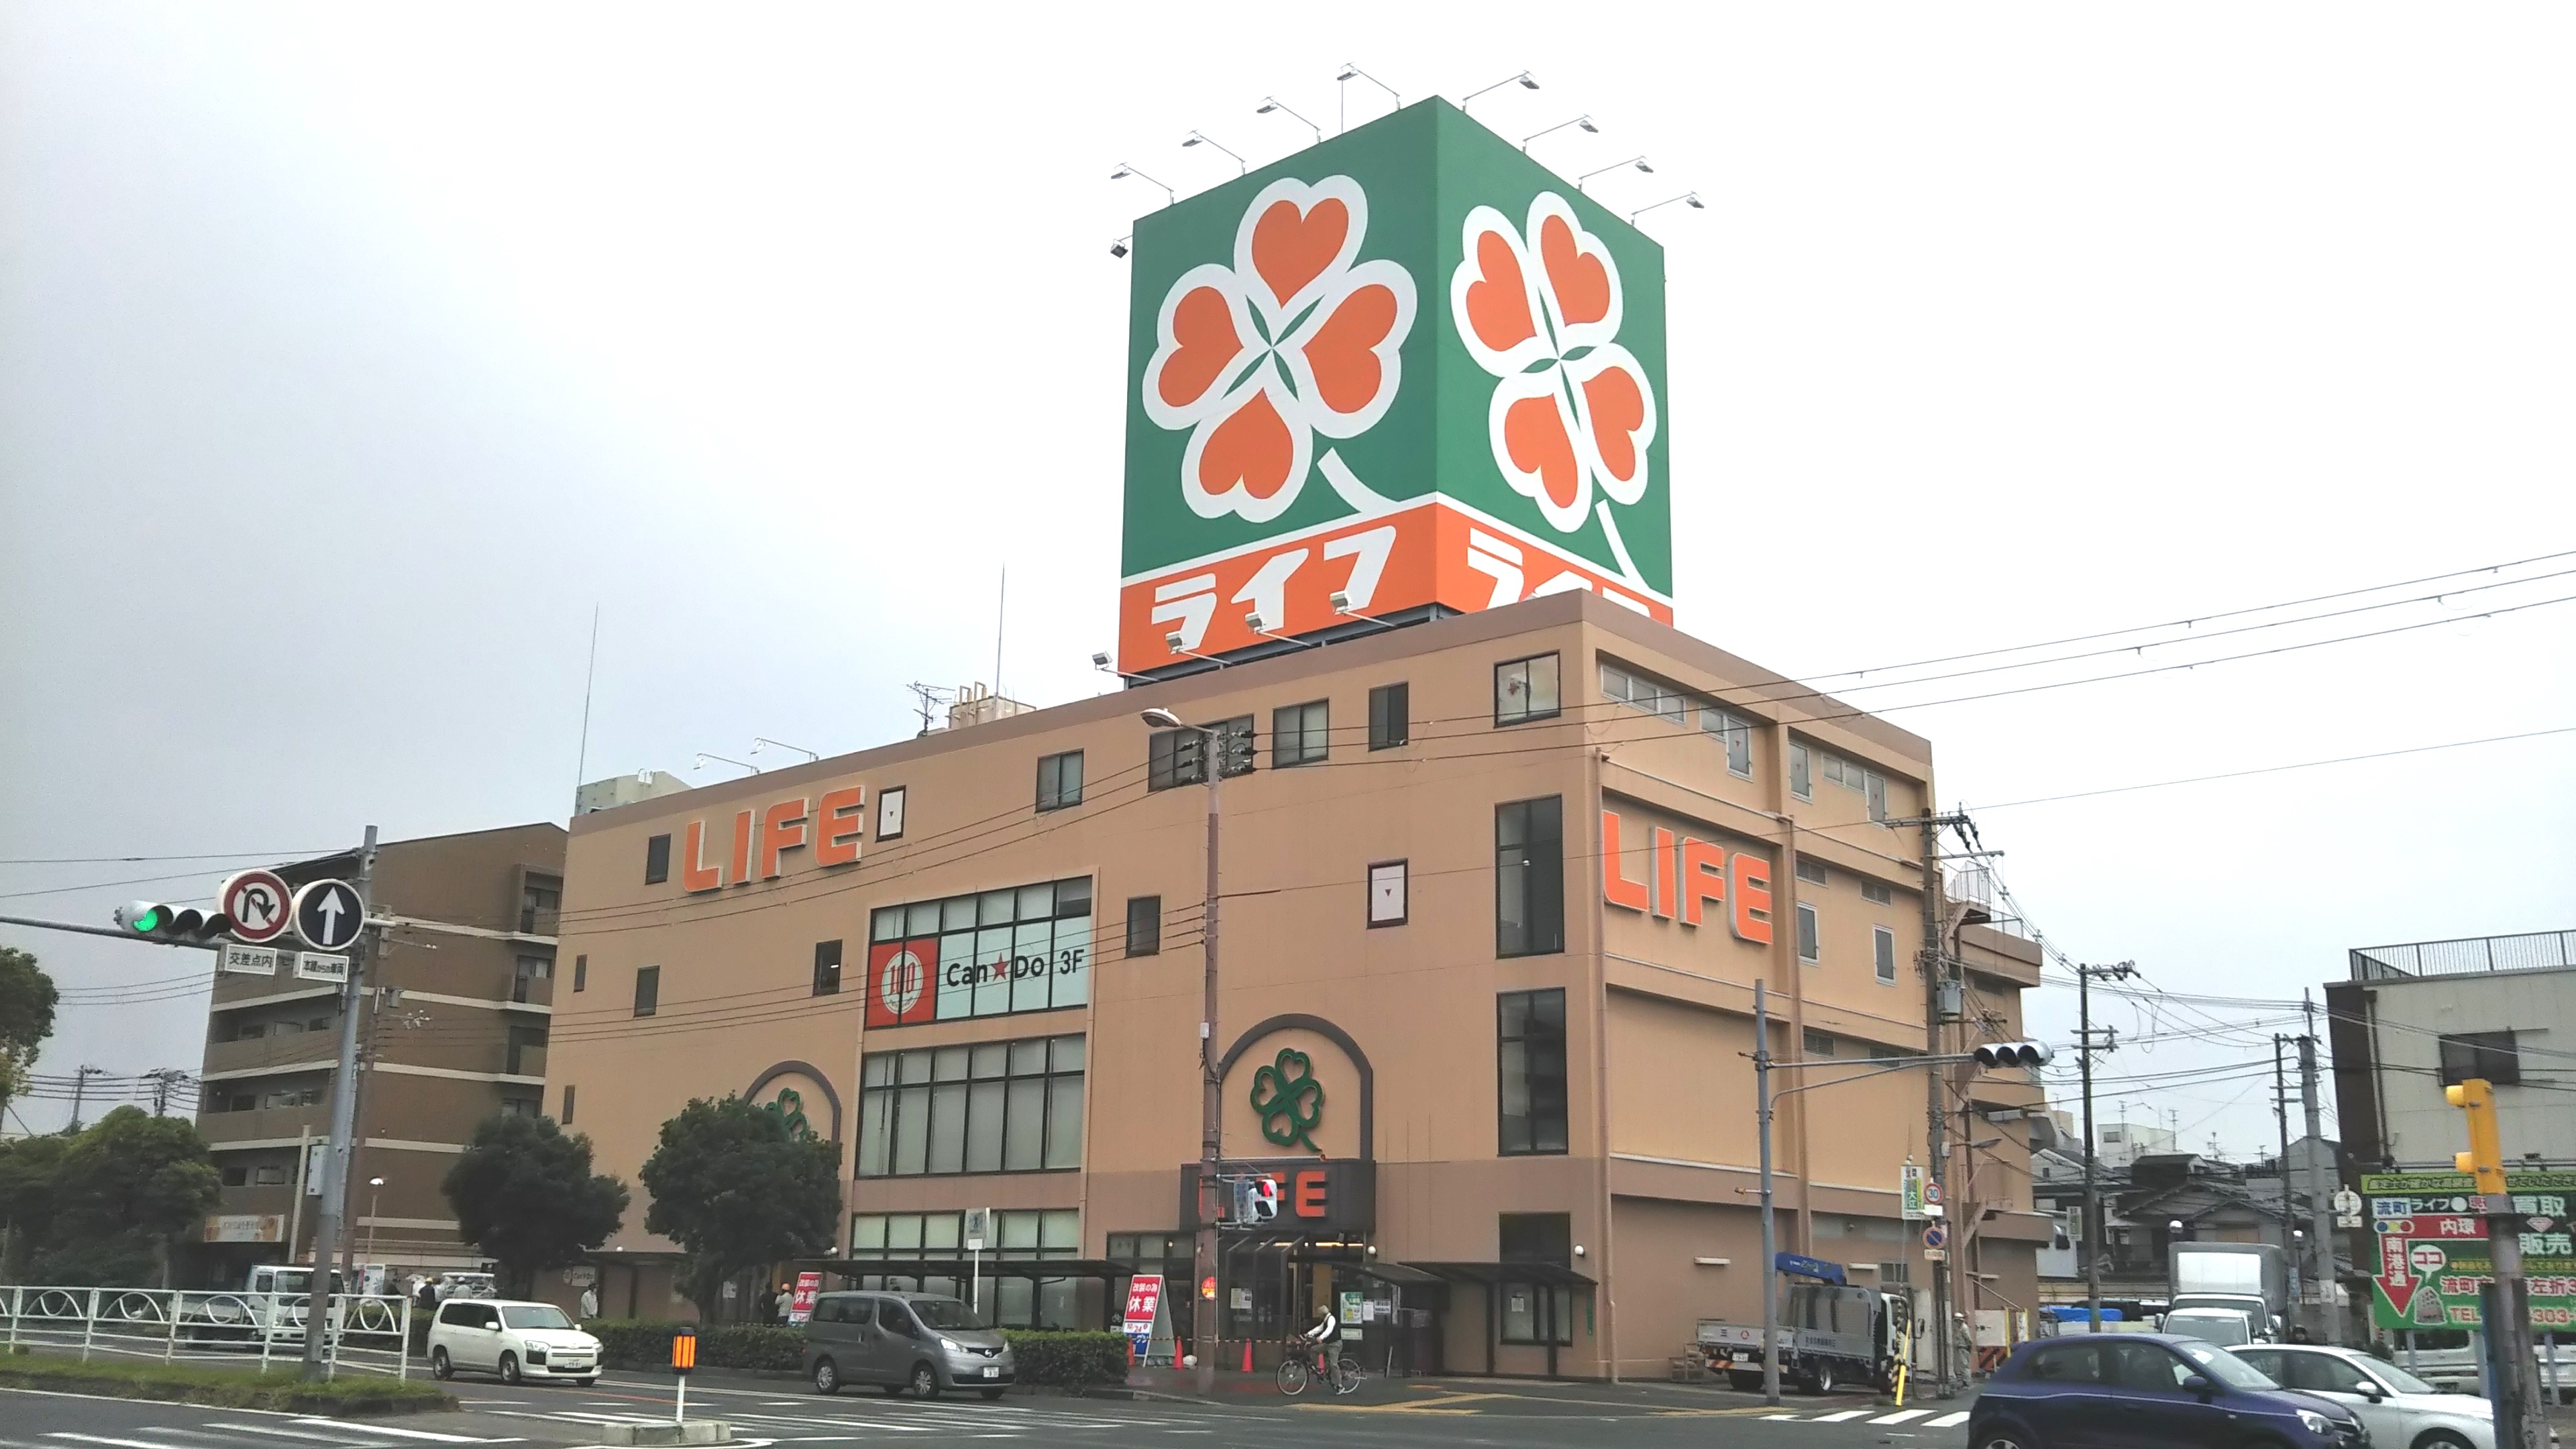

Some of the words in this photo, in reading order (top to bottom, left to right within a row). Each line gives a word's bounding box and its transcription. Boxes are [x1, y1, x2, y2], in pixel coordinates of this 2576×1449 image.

[1151, 525, 1397, 649] ライフ
[683, 785, 866, 893] LIFE
[1602, 809, 1772, 945] LIFE
[229, 952, 273, 968] 交差点内
[1060, 949, 1085, 975] 3F
[1928, 1189, 1939, 1199] 30
[2375, 1200, 2408, 1215] 流町
[2412, 1198, 2449, 1211] ライフ
[2512, 1195, 2567, 1217] 買取
[2440, 1218, 2477, 1235] 内環
[2518, 1232, 2573, 1255] 販売
[2385, 1237, 2407, 1287] 南港通
[2414, 1251, 2443, 1265] ココ
[794, 1289, 817, 1305] 休業
[1128, 1295, 1156, 1313] 休業
[2449, 1307, 2481, 1322] TEL
[2530, 1308, 2576, 1323] 303-
